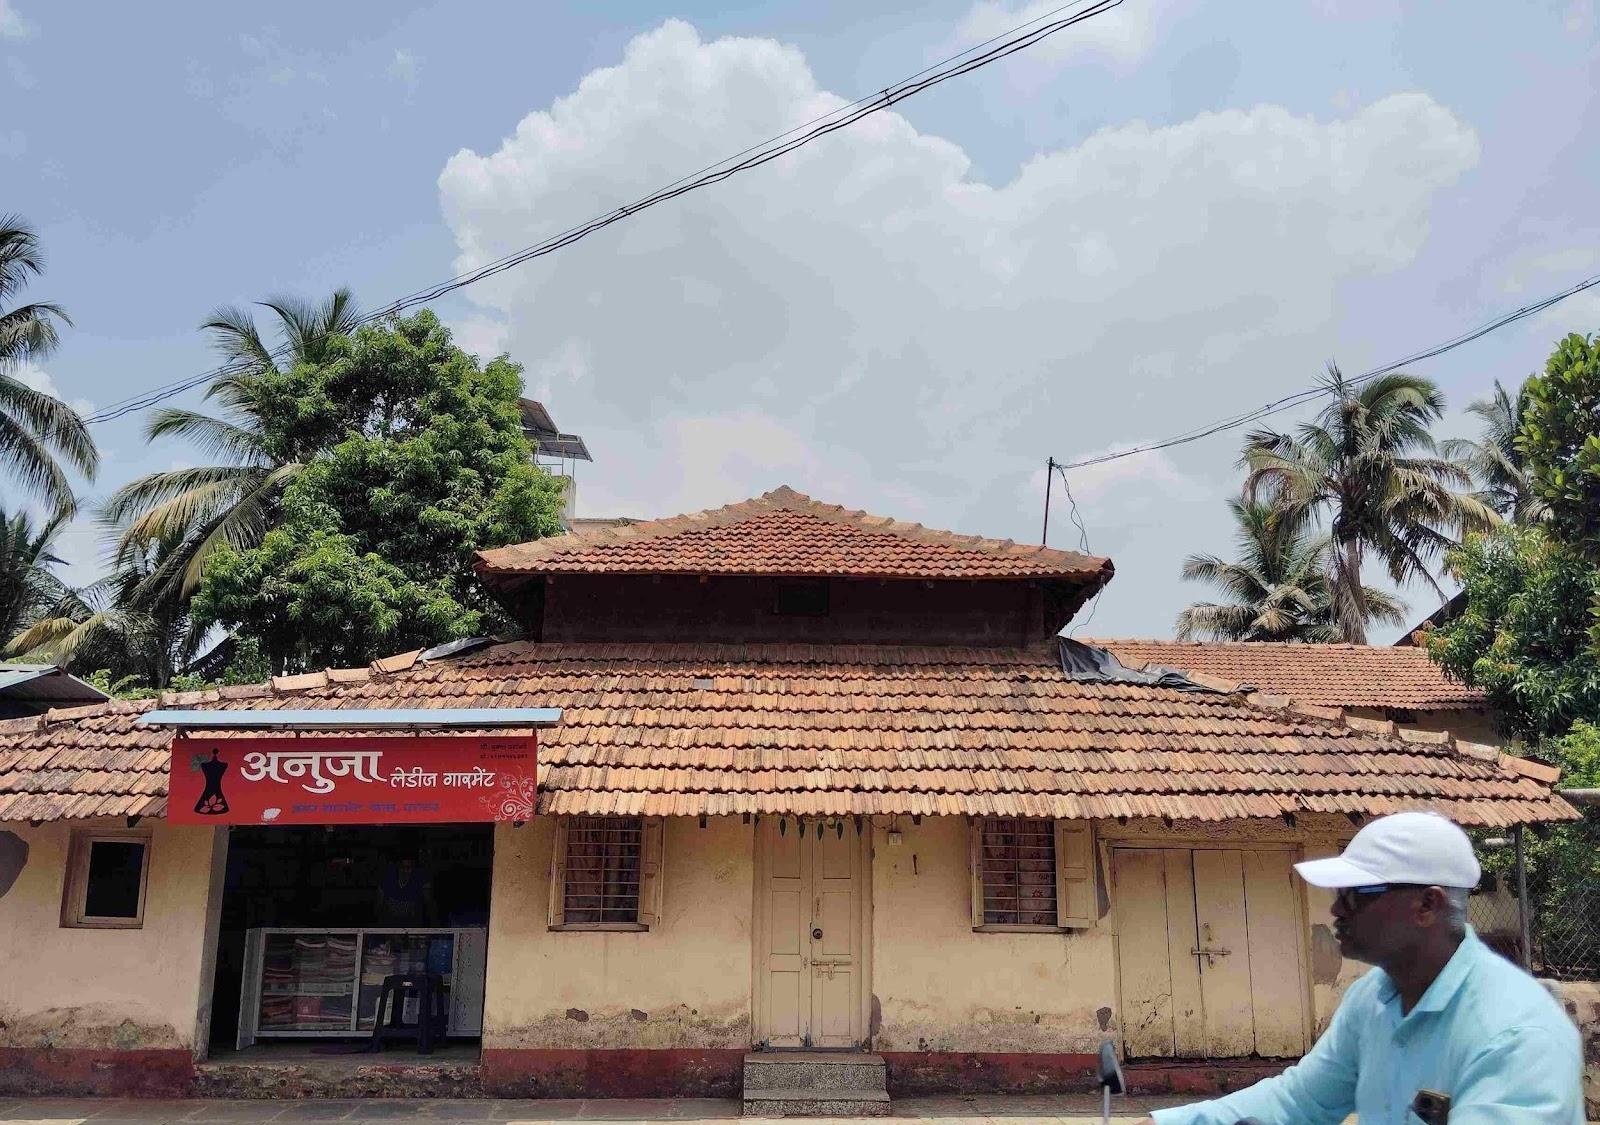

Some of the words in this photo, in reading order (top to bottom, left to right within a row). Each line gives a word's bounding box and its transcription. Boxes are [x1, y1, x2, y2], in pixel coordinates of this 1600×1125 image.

[240, 751, 388, 794] अनुजा
[390, 766, 438, 788] लेडीज
[443, 766, 496, 789] गारमेंट
